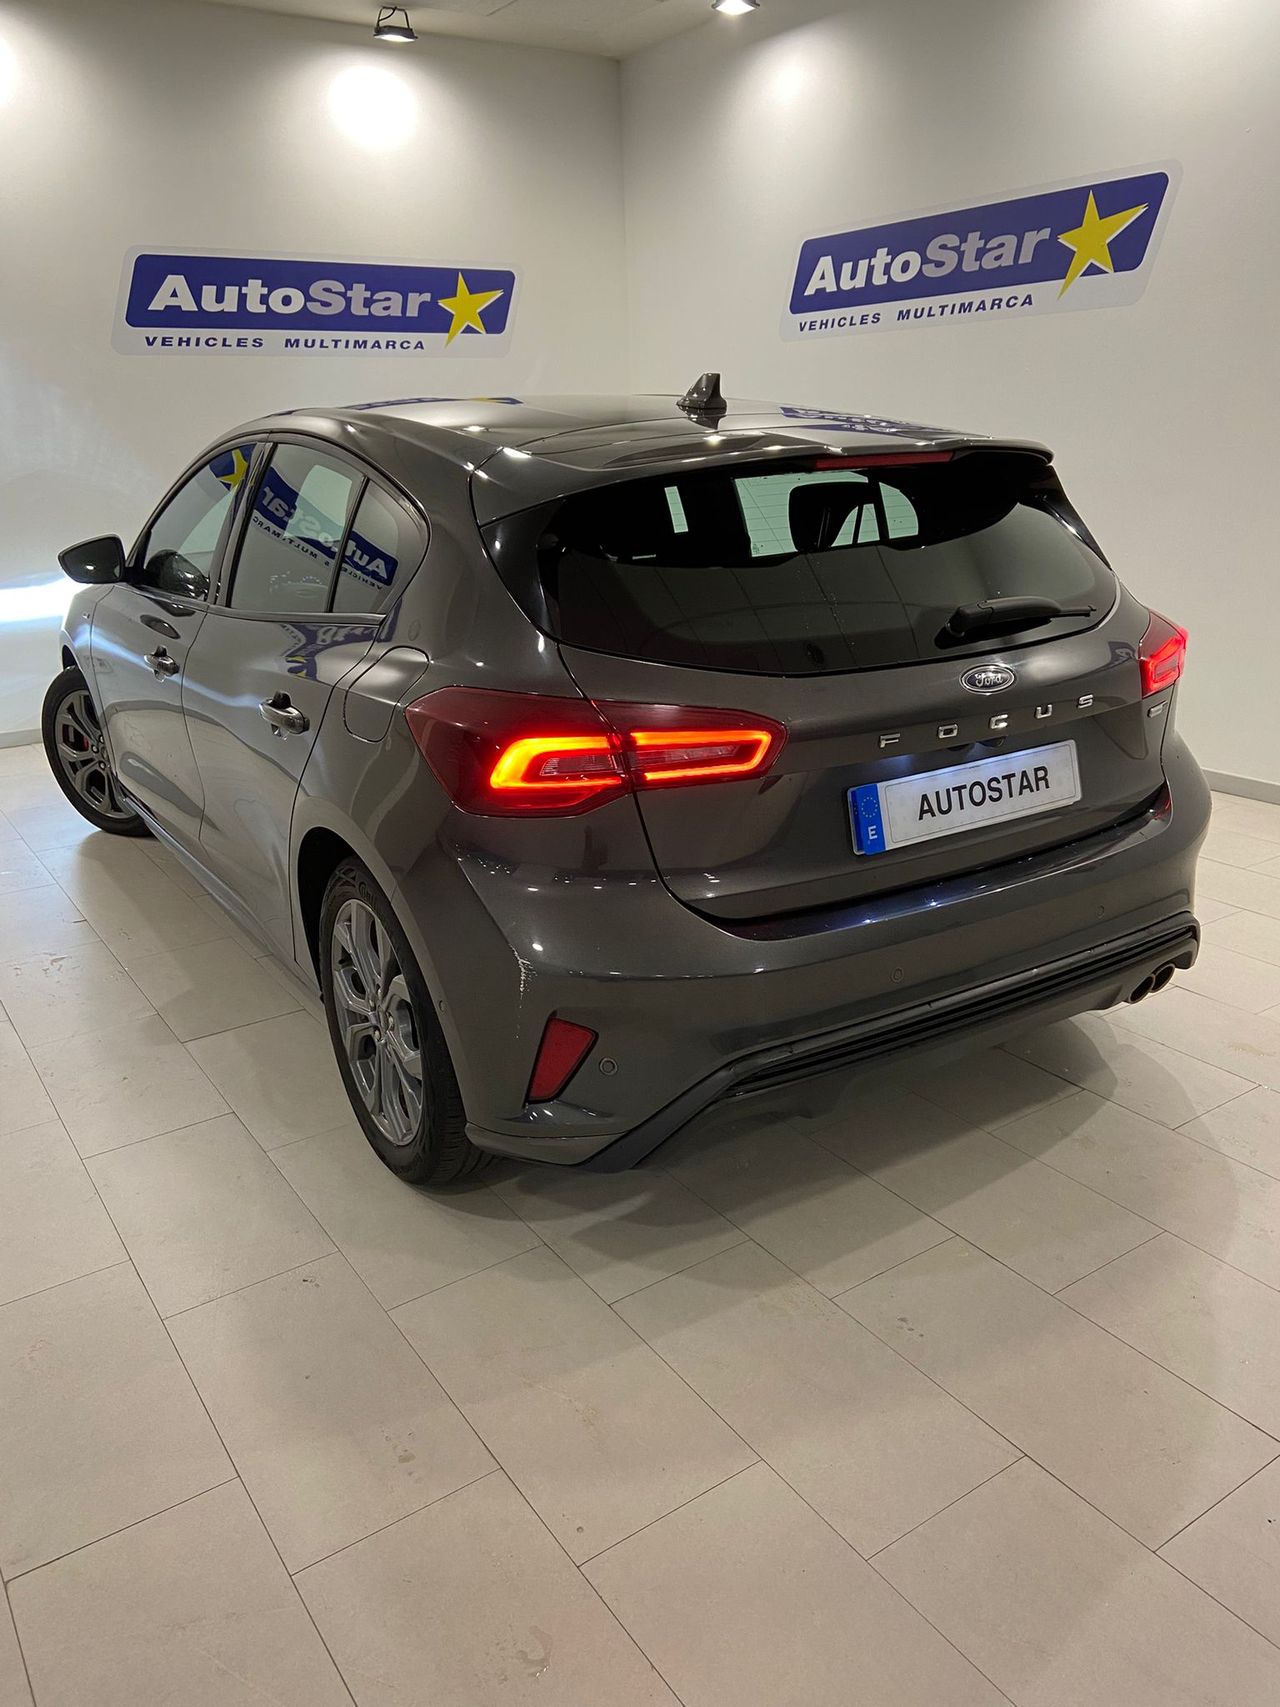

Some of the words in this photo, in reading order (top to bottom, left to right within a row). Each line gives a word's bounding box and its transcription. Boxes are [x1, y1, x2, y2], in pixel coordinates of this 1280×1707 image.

[803, 227, 1051, 297] AutoStar
[147, 274, 431, 317] AutoStar
[798, 312, 882, 332] VEHICLES
[896, 293, 1034, 322] MULTIMARCA
[144, 335, 264, 348] VEHICLES
[284, 337, 425, 351] MULTIMARCA
[879, 693, 1094, 749] FOCUS
[917, 764, 1051, 822] AUTOSTAR
[867, 824, 878, 840] E
